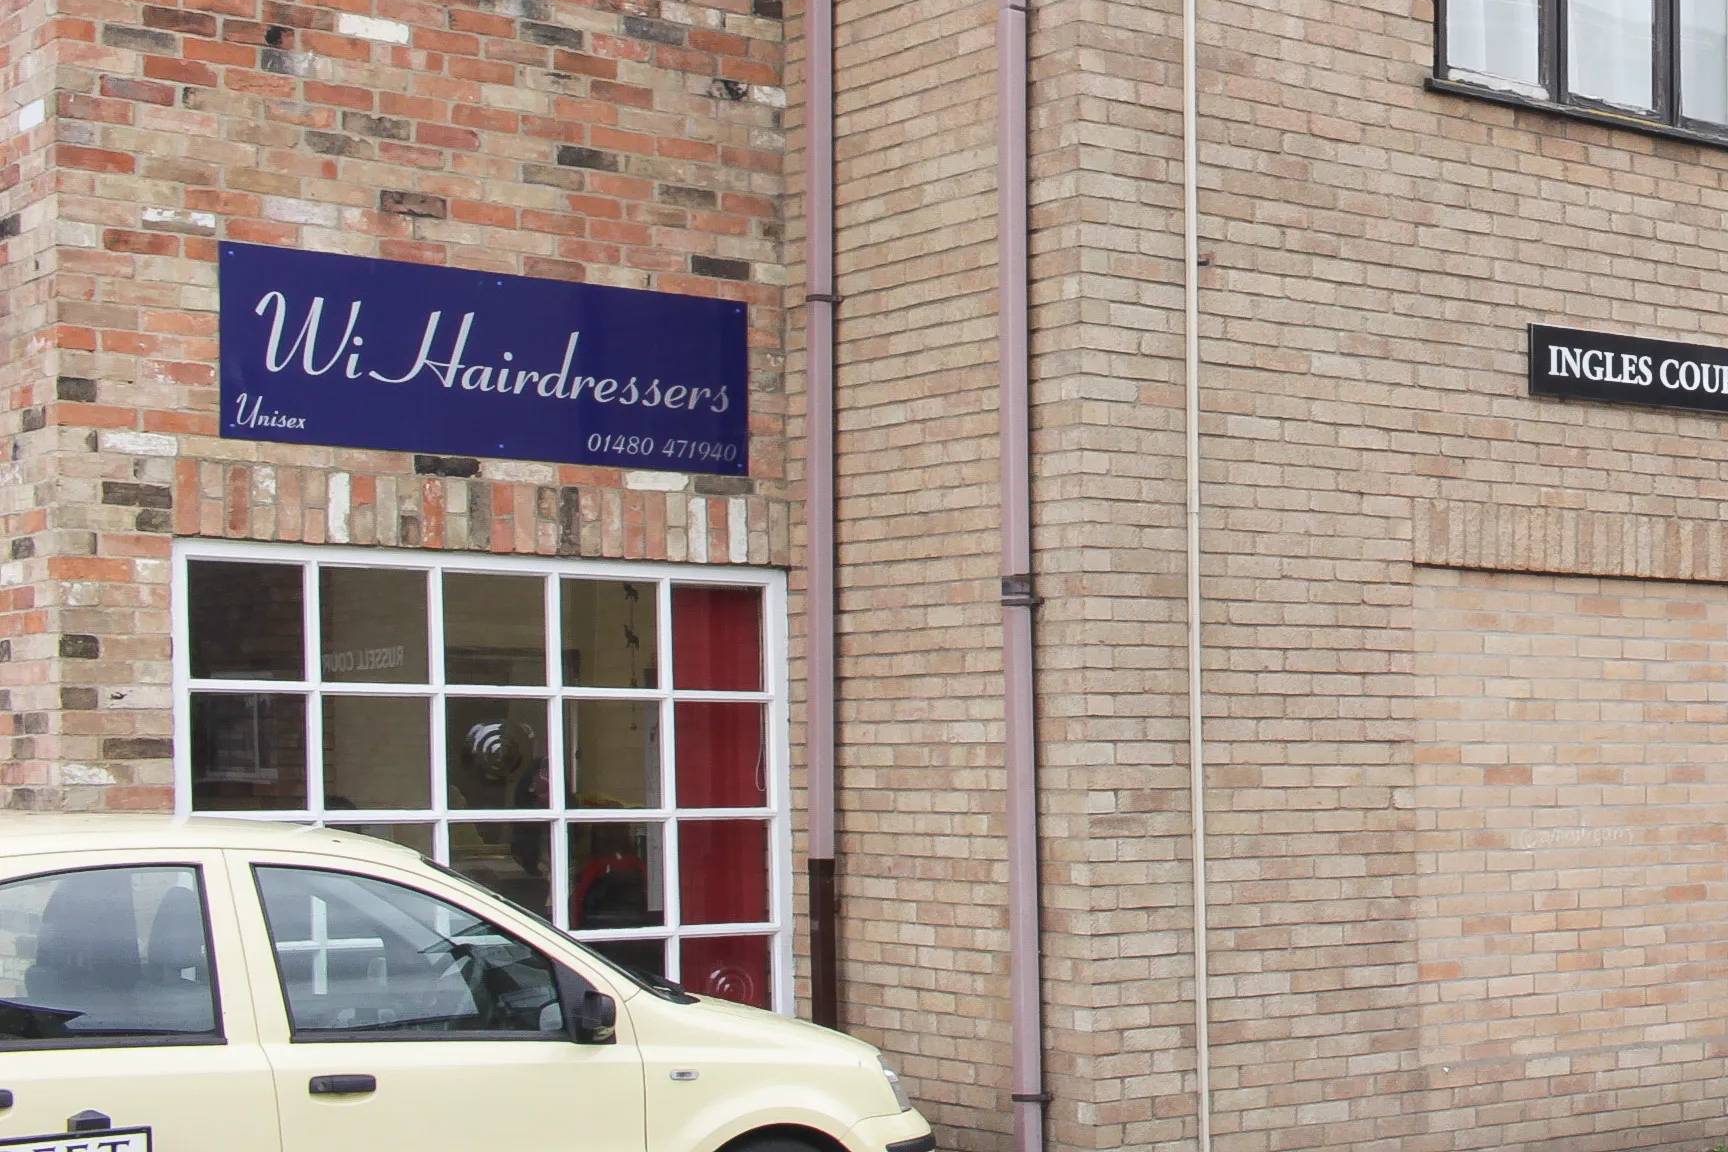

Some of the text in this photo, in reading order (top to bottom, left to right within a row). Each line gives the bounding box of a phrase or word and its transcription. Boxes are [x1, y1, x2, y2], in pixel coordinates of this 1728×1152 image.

[255, 291, 729, 412] Wi Hairdressers
[1548, 345, 1653, 386] INGLES
[236, 392, 306, 430] Unisex
[587, 433, 737, 462] 01480 471940
